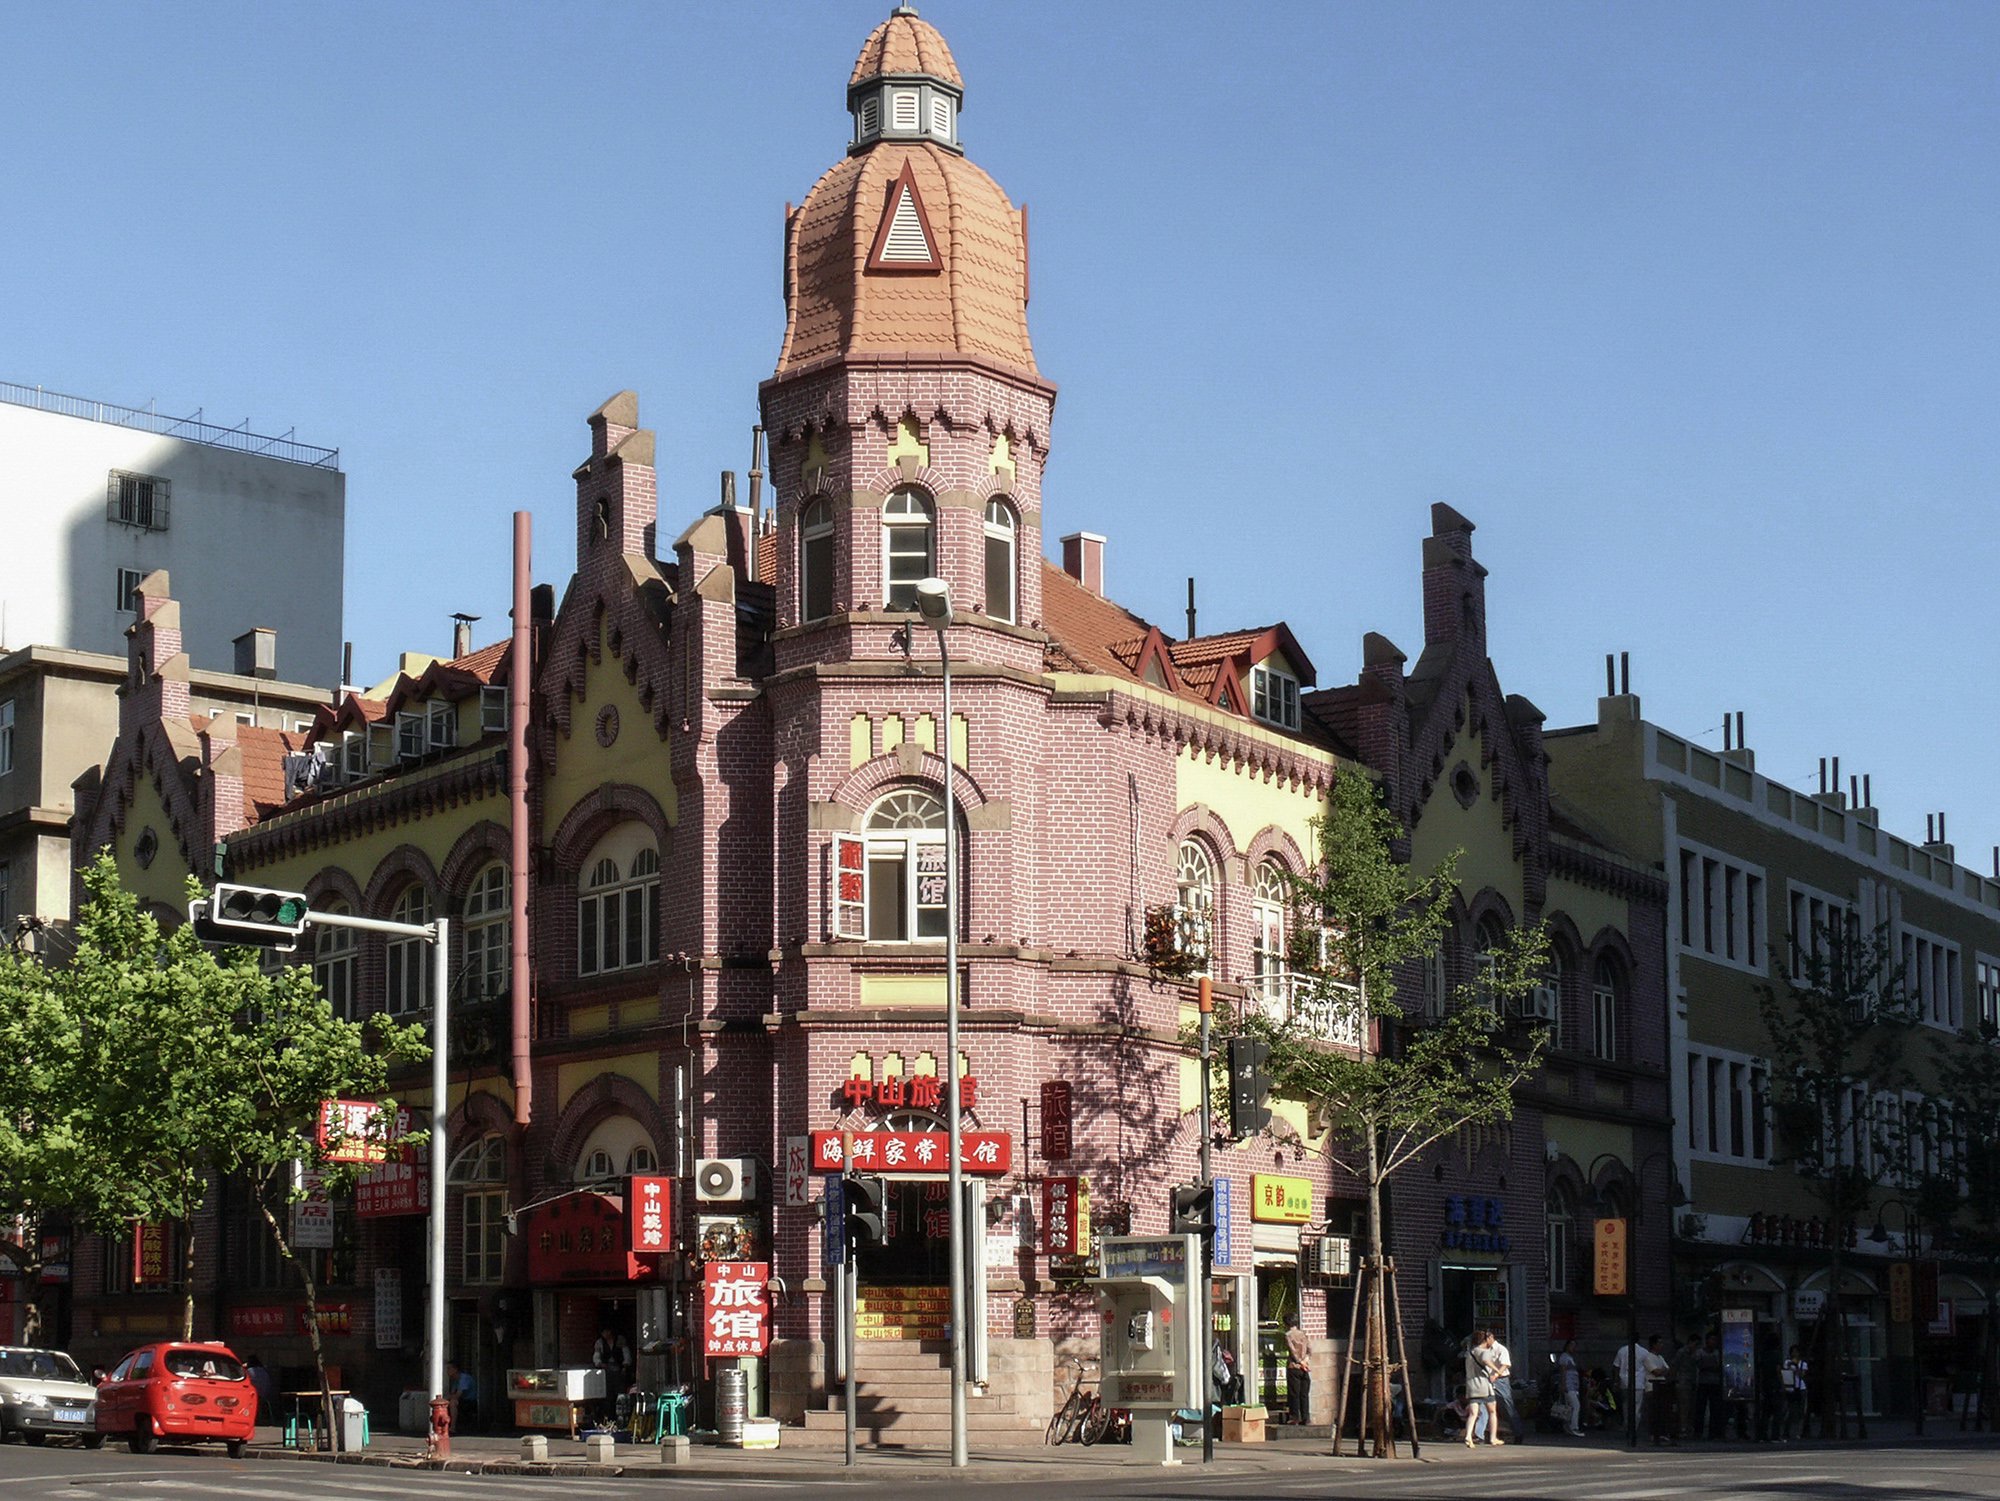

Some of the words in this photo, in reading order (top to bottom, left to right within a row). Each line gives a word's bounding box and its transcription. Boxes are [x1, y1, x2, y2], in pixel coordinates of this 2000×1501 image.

[919, 845, 947, 904] 旅馆
[1042, 1087, 1067, 1154] 旅馆
[788, 1146, 806, 1202] 旅馆
[642, 1181, 662, 1246] 中山烧烤
[1216, 1180, 1228, 1264] 请您看信号通行
[143, 1222, 162, 1276] 庆酸辣粉
[717, 1264, 756, 1277] 中山
[1160, 1247, 1185, 1261] 114
[708, 1279, 763, 1338] 旅馆
[708, 1340, 763, 1352] 钟点休息
